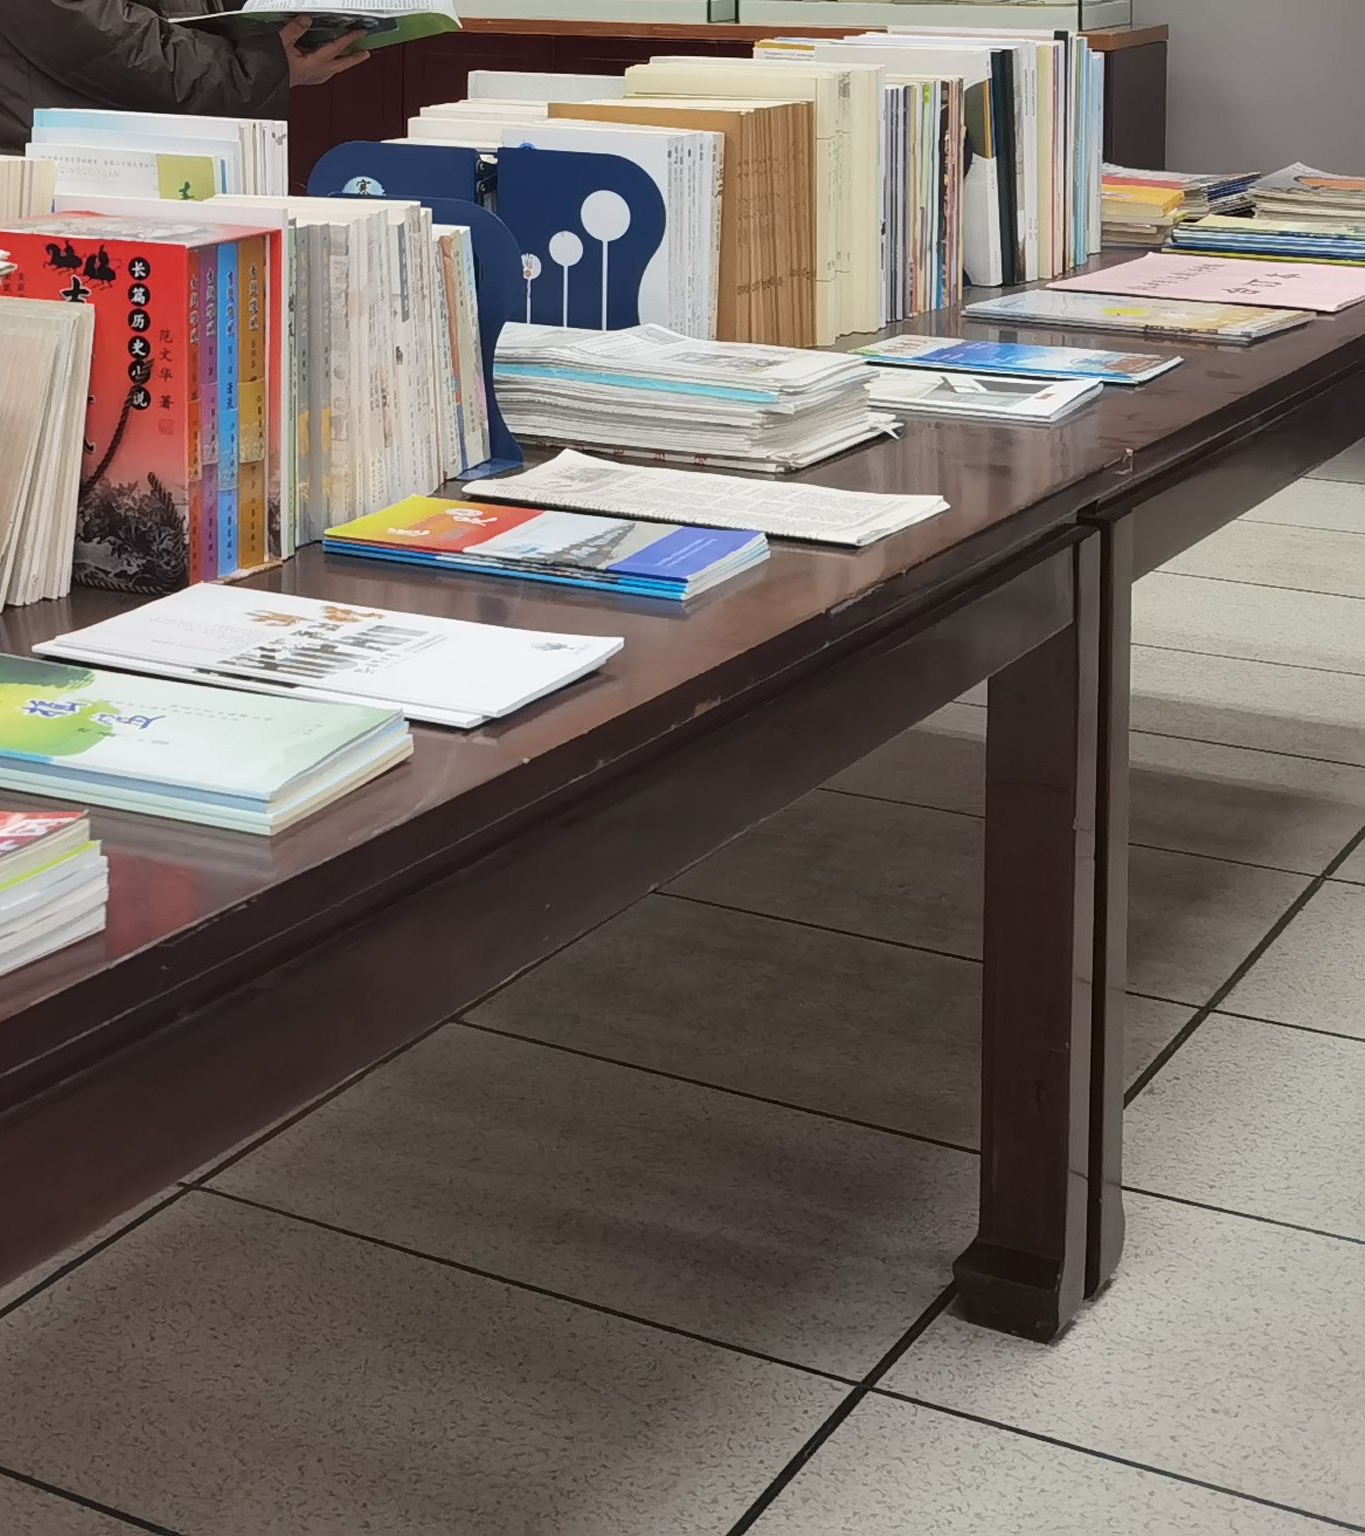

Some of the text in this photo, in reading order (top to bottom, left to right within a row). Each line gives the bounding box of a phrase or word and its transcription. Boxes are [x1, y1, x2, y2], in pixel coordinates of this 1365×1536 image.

[129, 257, 151, 409] 长篇历史小说
